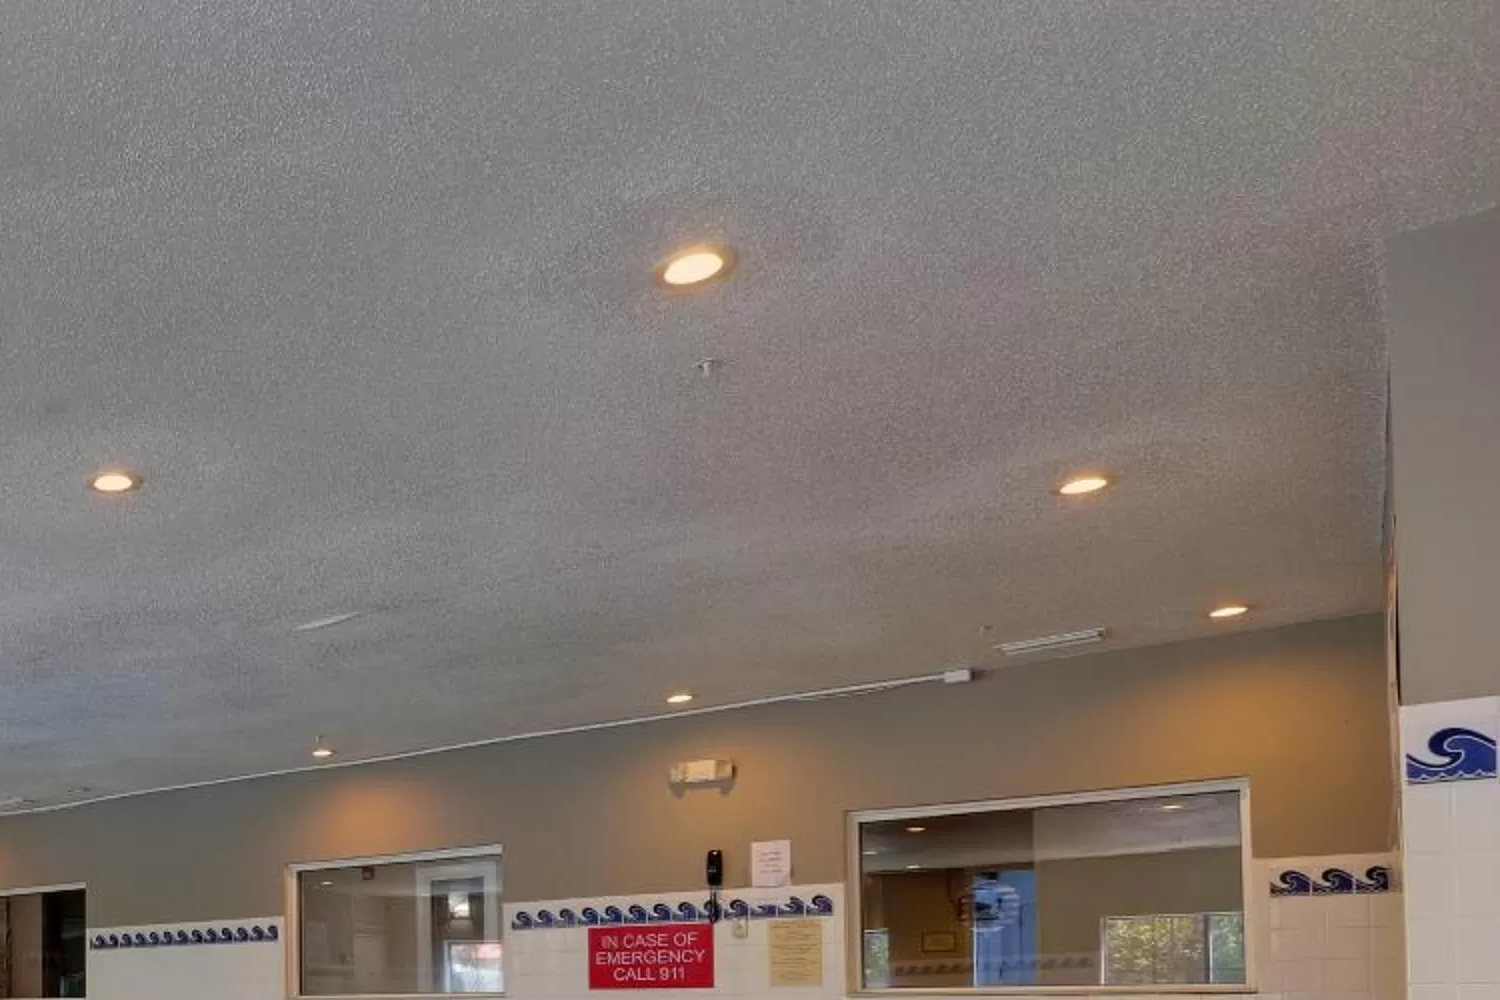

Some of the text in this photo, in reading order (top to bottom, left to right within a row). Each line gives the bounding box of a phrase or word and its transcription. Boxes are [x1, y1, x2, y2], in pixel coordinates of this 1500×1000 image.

[602, 931, 698, 949] IN CASE OF
[595, 949, 705, 966] EMERGENCY
[613, 965, 686, 981] CALL 911
